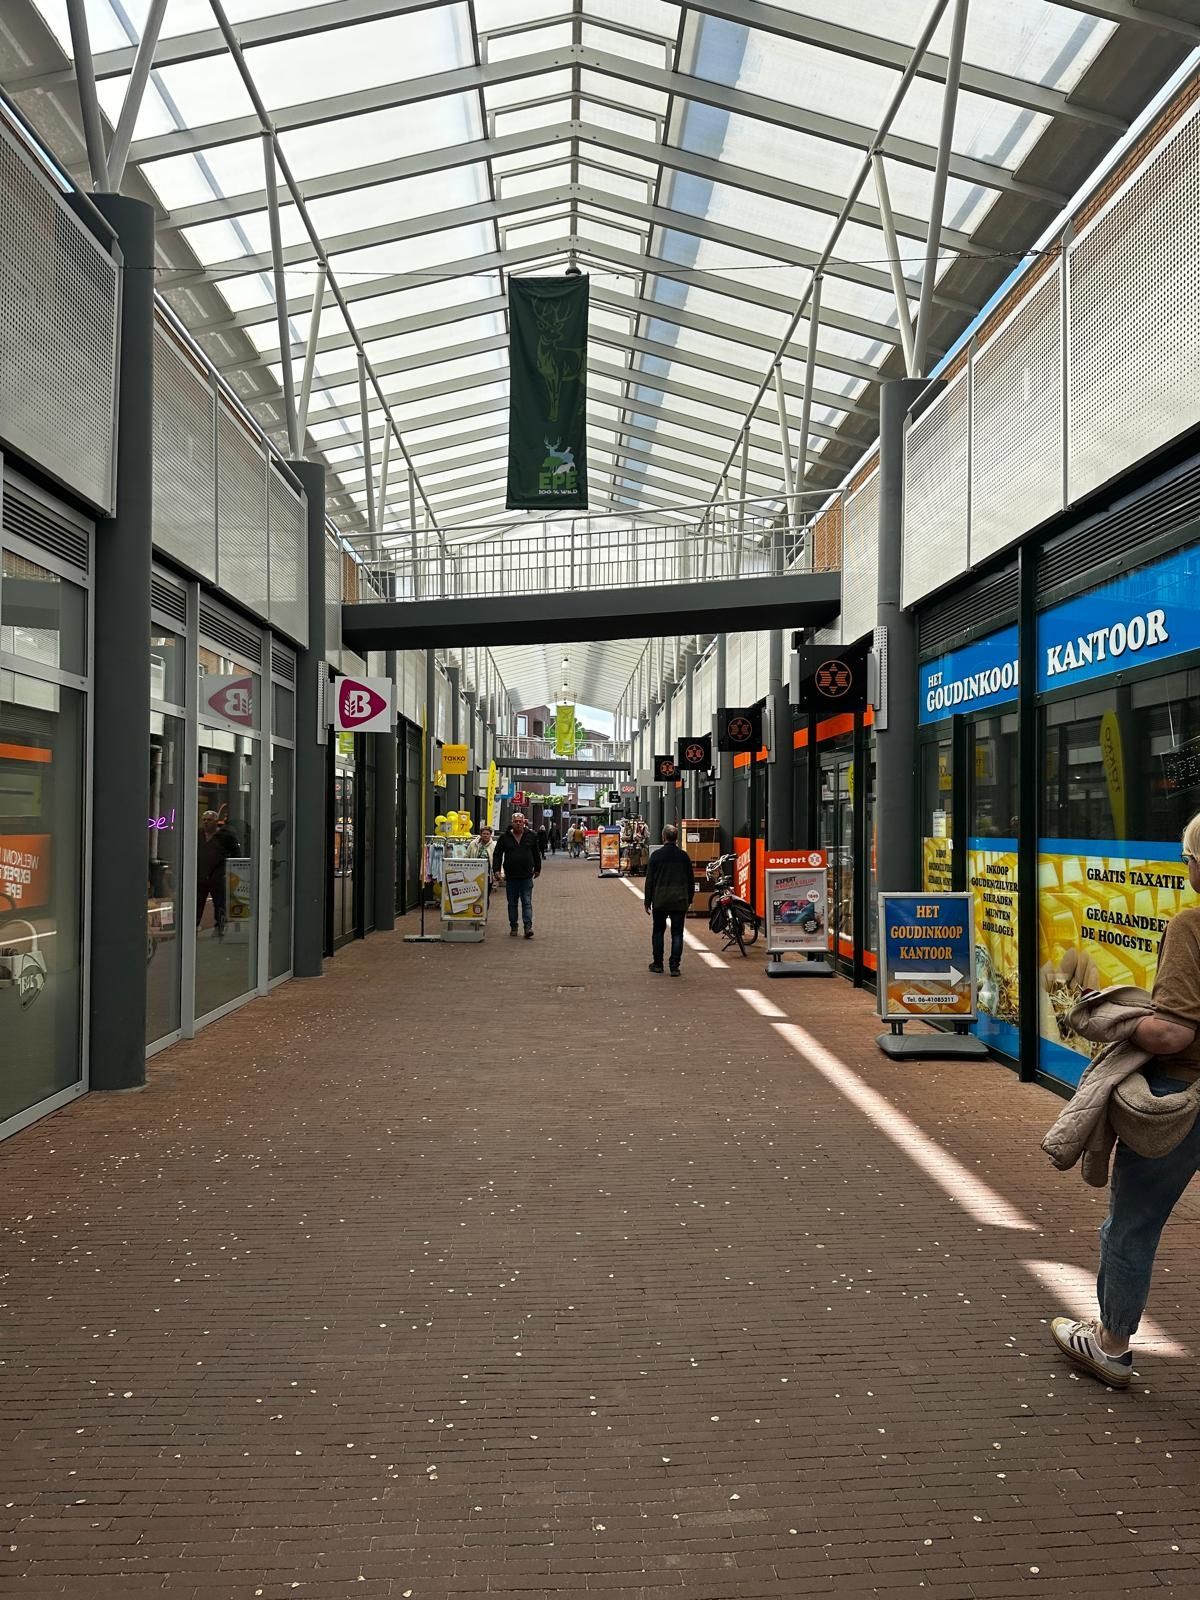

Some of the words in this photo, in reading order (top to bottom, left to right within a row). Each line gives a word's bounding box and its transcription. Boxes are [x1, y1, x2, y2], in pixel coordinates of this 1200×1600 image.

[539, 471, 577, 490] EPE
[1046, 608, 1169, 676] KANTOOR
[927, 671, 943, 689] HET
[769, 857, 807, 865] expert
[986, 864, 1009, 876] INKOOP
[1086, 868, 1126, 884] GRATIS
[1129, 871, 1185, 890] TAXATIE
[982, 893, 1013, 906] SIERADEN
[916, 905, 940, 918] HET
[985, 907, 1011, 920] MUNTEN
[890, 926, 963, 939] GOUDINKOOP
[982, 921, 1014, 937] HORLOGES
[1081, 926, 1096, 940] DE
[1098, 929, 1152, 953] HOOGSTE
[900, 946, 953, 960] KANTOOR
